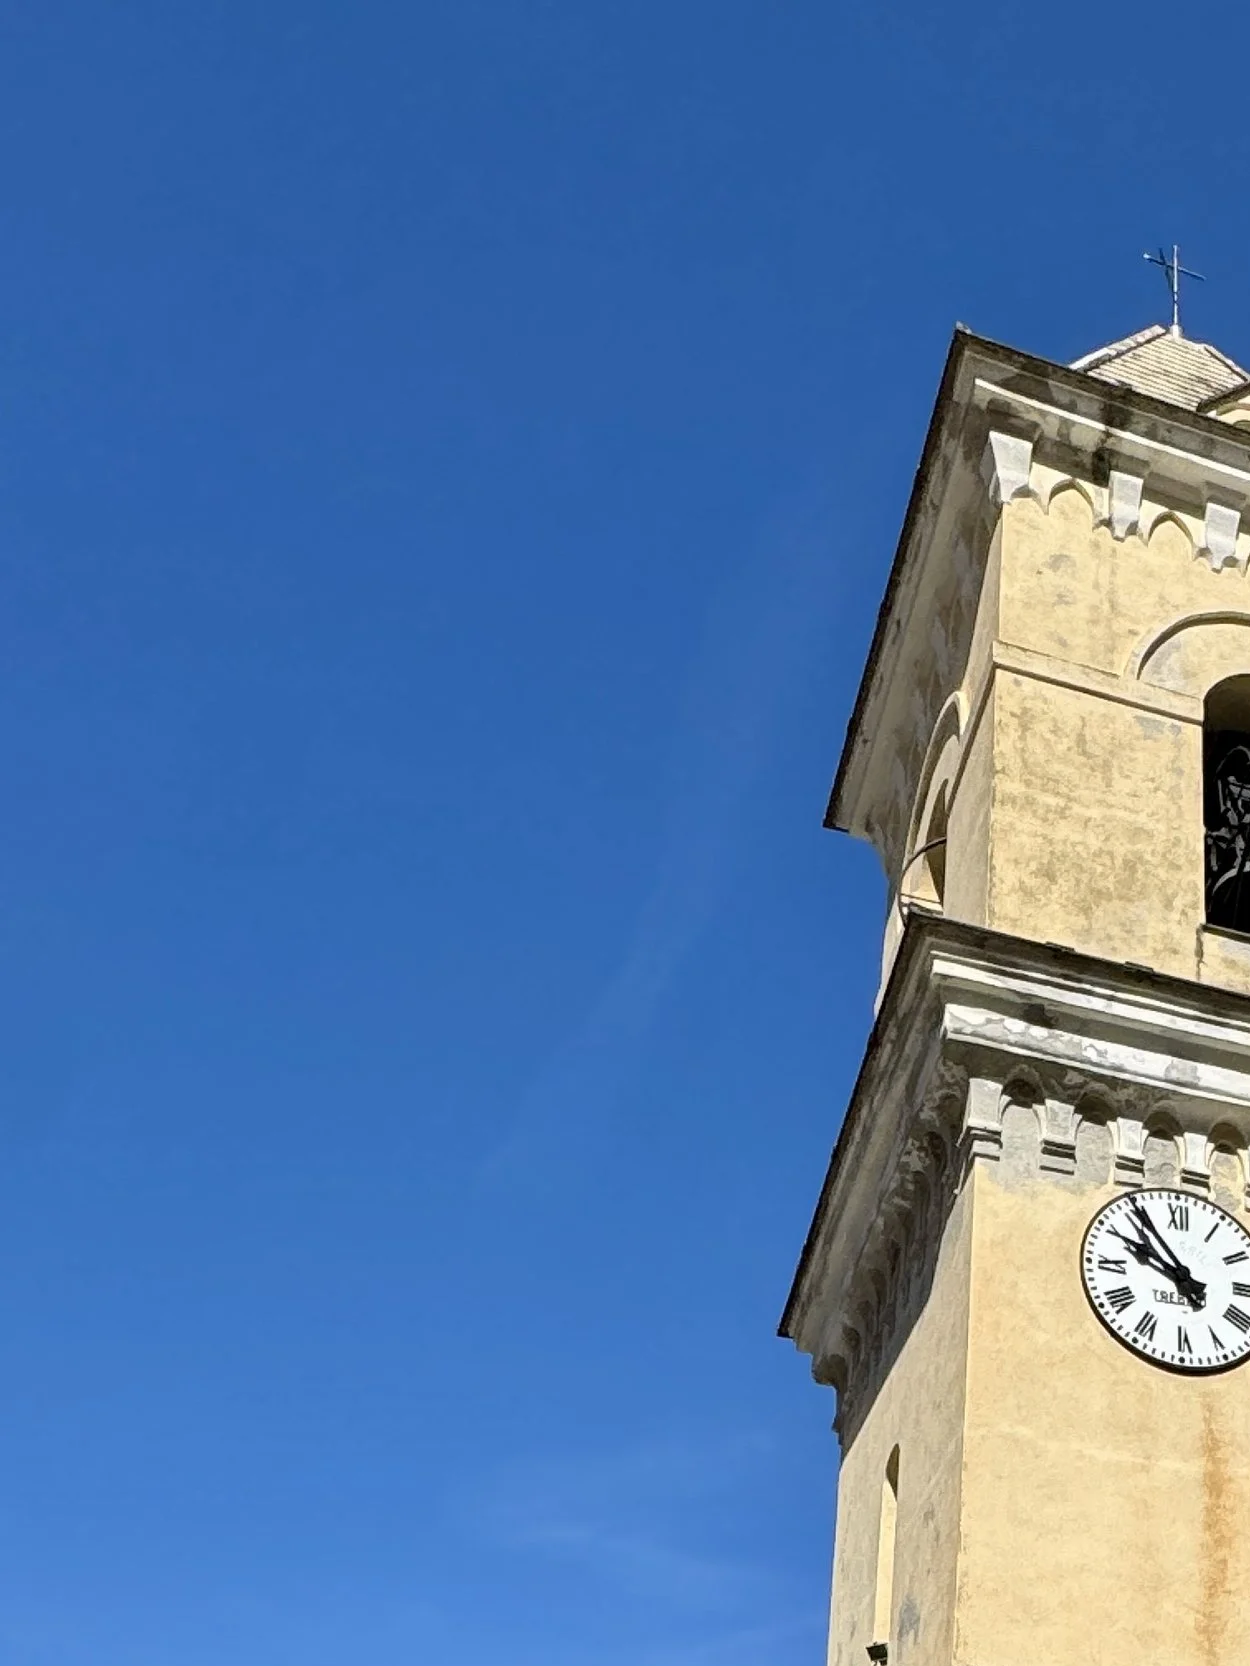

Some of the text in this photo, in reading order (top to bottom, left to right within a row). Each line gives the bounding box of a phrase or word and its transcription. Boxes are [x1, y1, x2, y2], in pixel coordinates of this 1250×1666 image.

[1167, 1203, 1189, 1232] XII
[1222, 1250, 1249, 1266] II
[1207, 1324, 1226, 1351] V
